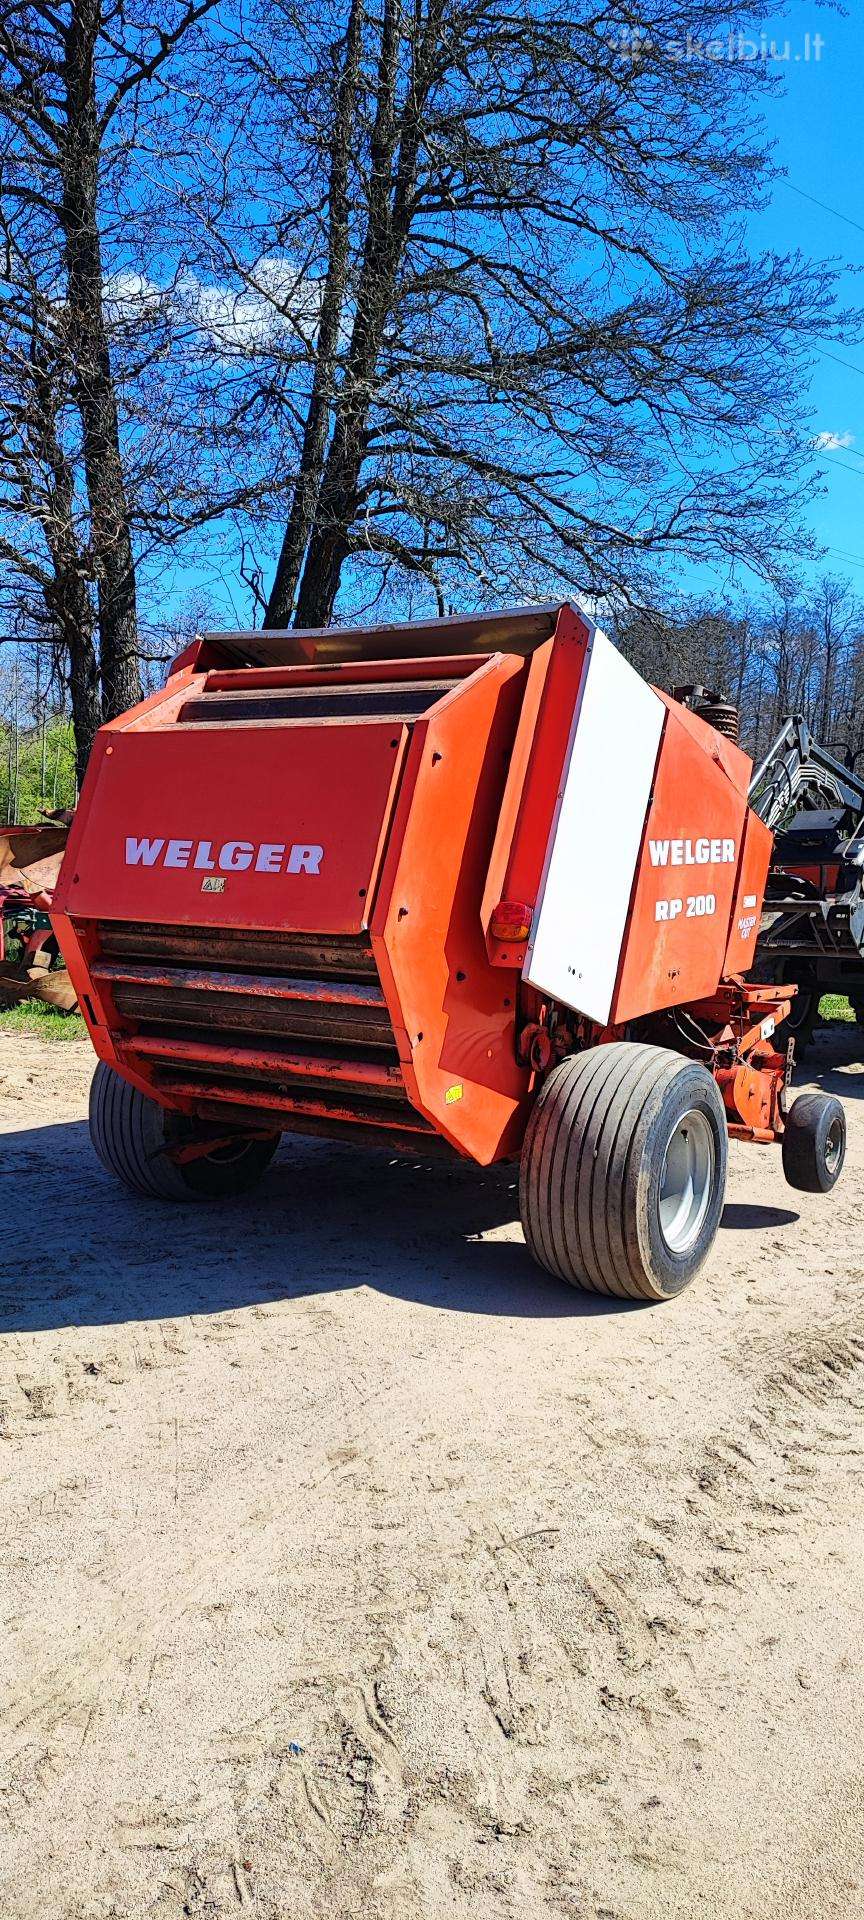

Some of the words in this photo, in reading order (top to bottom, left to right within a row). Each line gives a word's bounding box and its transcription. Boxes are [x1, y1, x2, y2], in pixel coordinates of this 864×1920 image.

[125, 837, 324, 875] WELGER
[648, 838, 735, 867] WELGER
[655, 898, 682, 921] RP
[686, 894, 716, 917] 200
